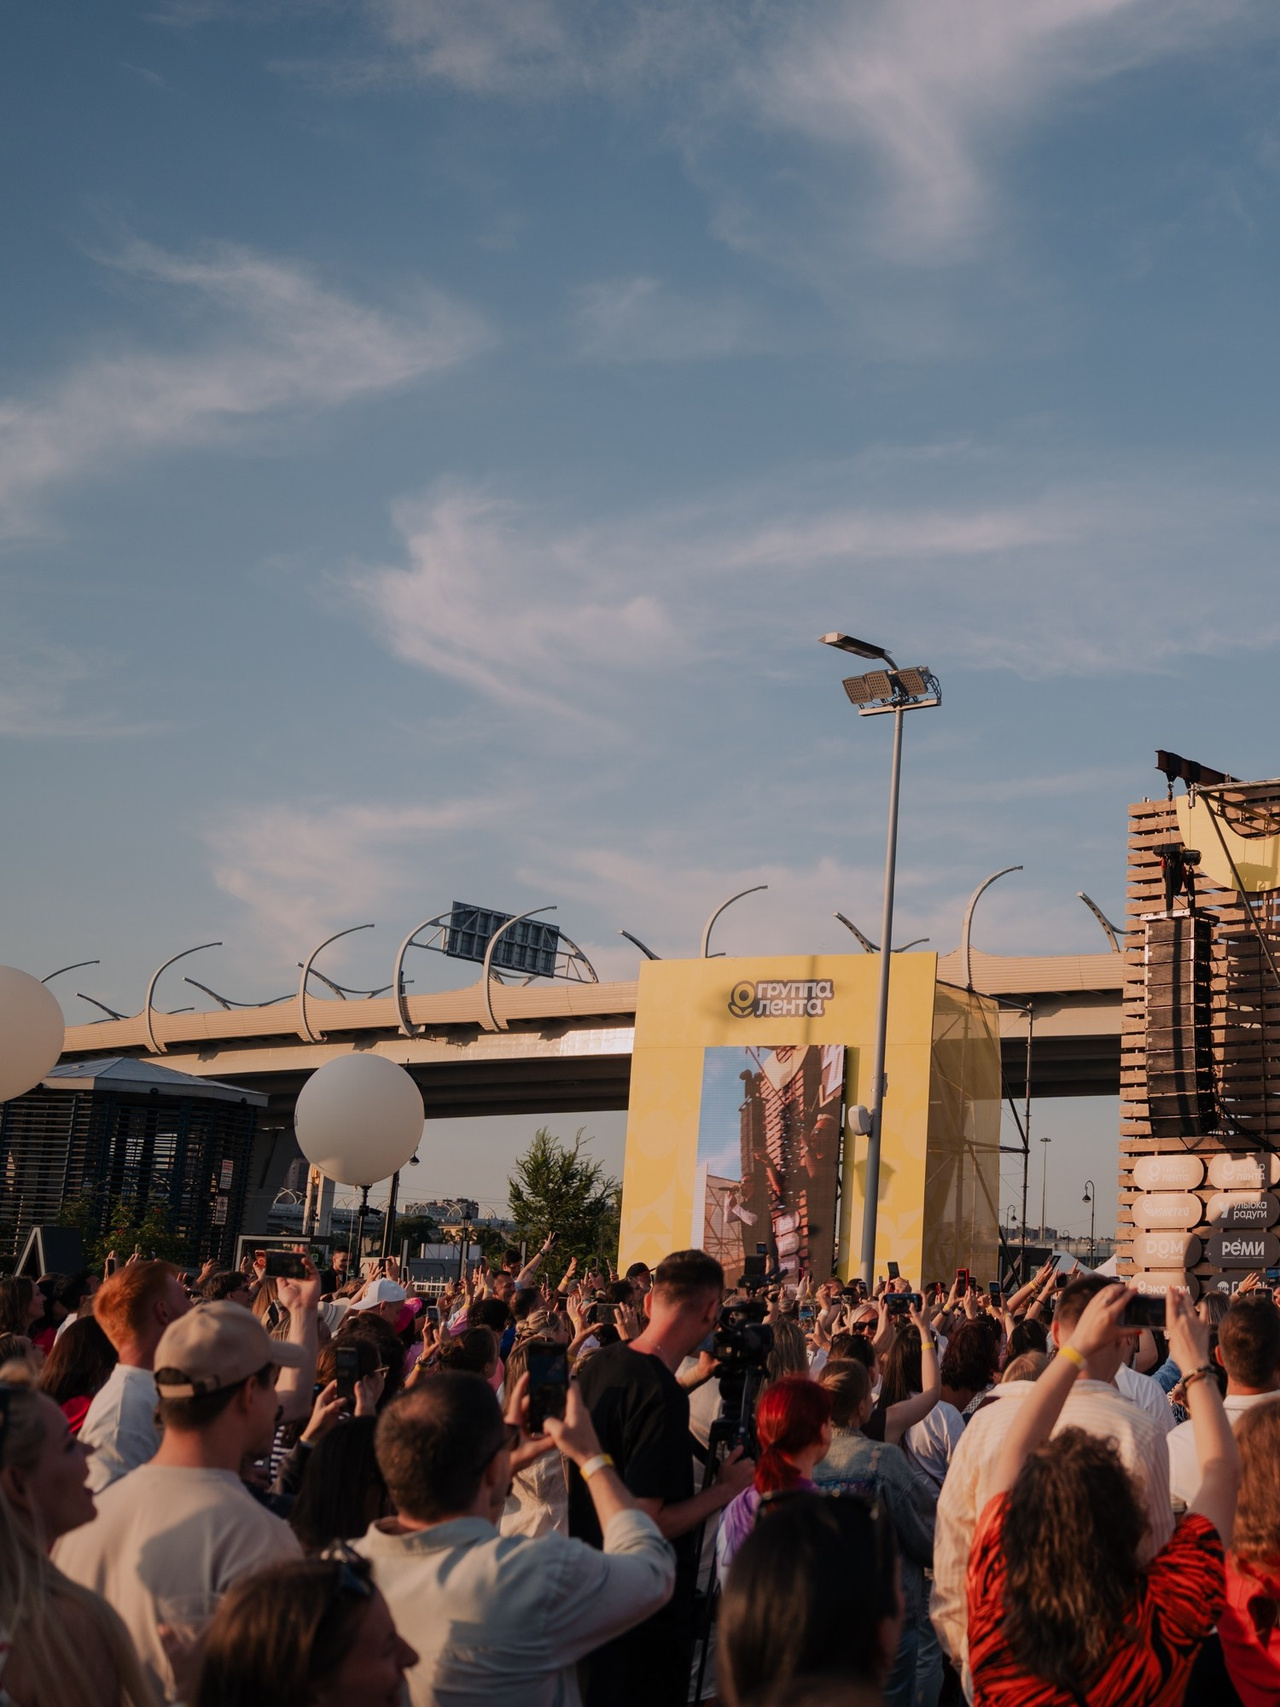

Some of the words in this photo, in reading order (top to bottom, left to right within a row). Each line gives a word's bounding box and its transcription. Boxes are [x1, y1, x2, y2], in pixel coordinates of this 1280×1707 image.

[757, 981, 833, 999] группа
[755, 998, 824, 1016] лента
[1236, 1172, 1265, 1181] лента
[1233, 1201, 1267, 1210] улыбка
[1233, 1210, 1267, 1220] радуги
[1146, 1285, 1191, 1295] экоом
